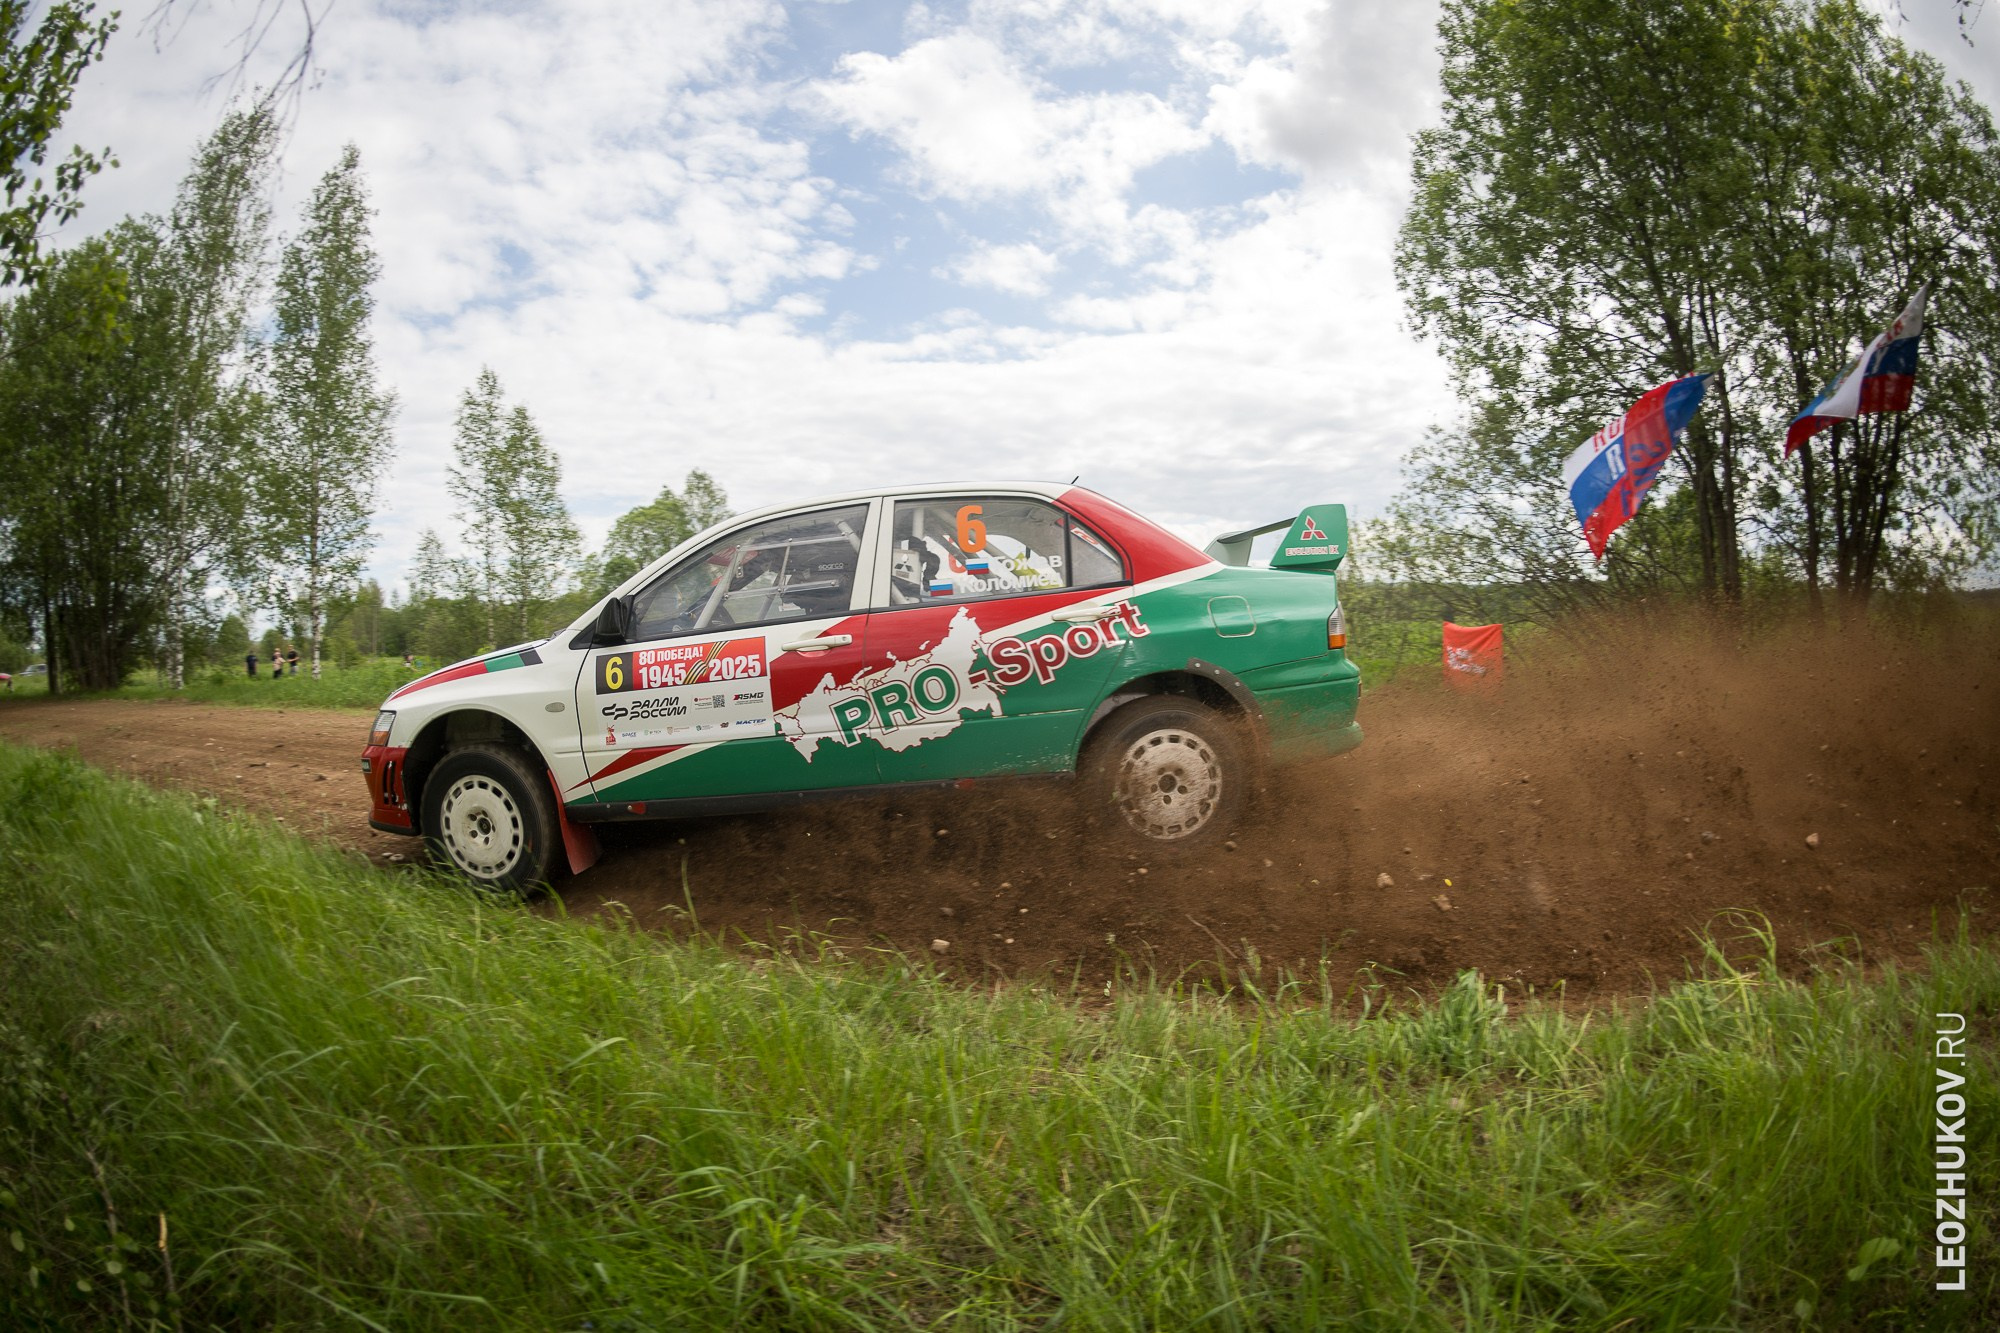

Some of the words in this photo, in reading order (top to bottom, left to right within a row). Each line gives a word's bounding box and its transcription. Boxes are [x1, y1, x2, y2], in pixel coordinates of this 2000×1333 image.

[956, 505, 986, 553] 6
[1328, 545, 1340, 555] IX
[638, 650, 656, 666] 80
[656, 646, 703, 662] ПОБЕДА!
[605, 656, 623, 690] 6
[638, 663, 687, 689] 1945
[708, 654, 761, 681] 2025
[629, 706, 687, 720] РОССИИ
[631, 697, 679, 710] РАЛЛИ
